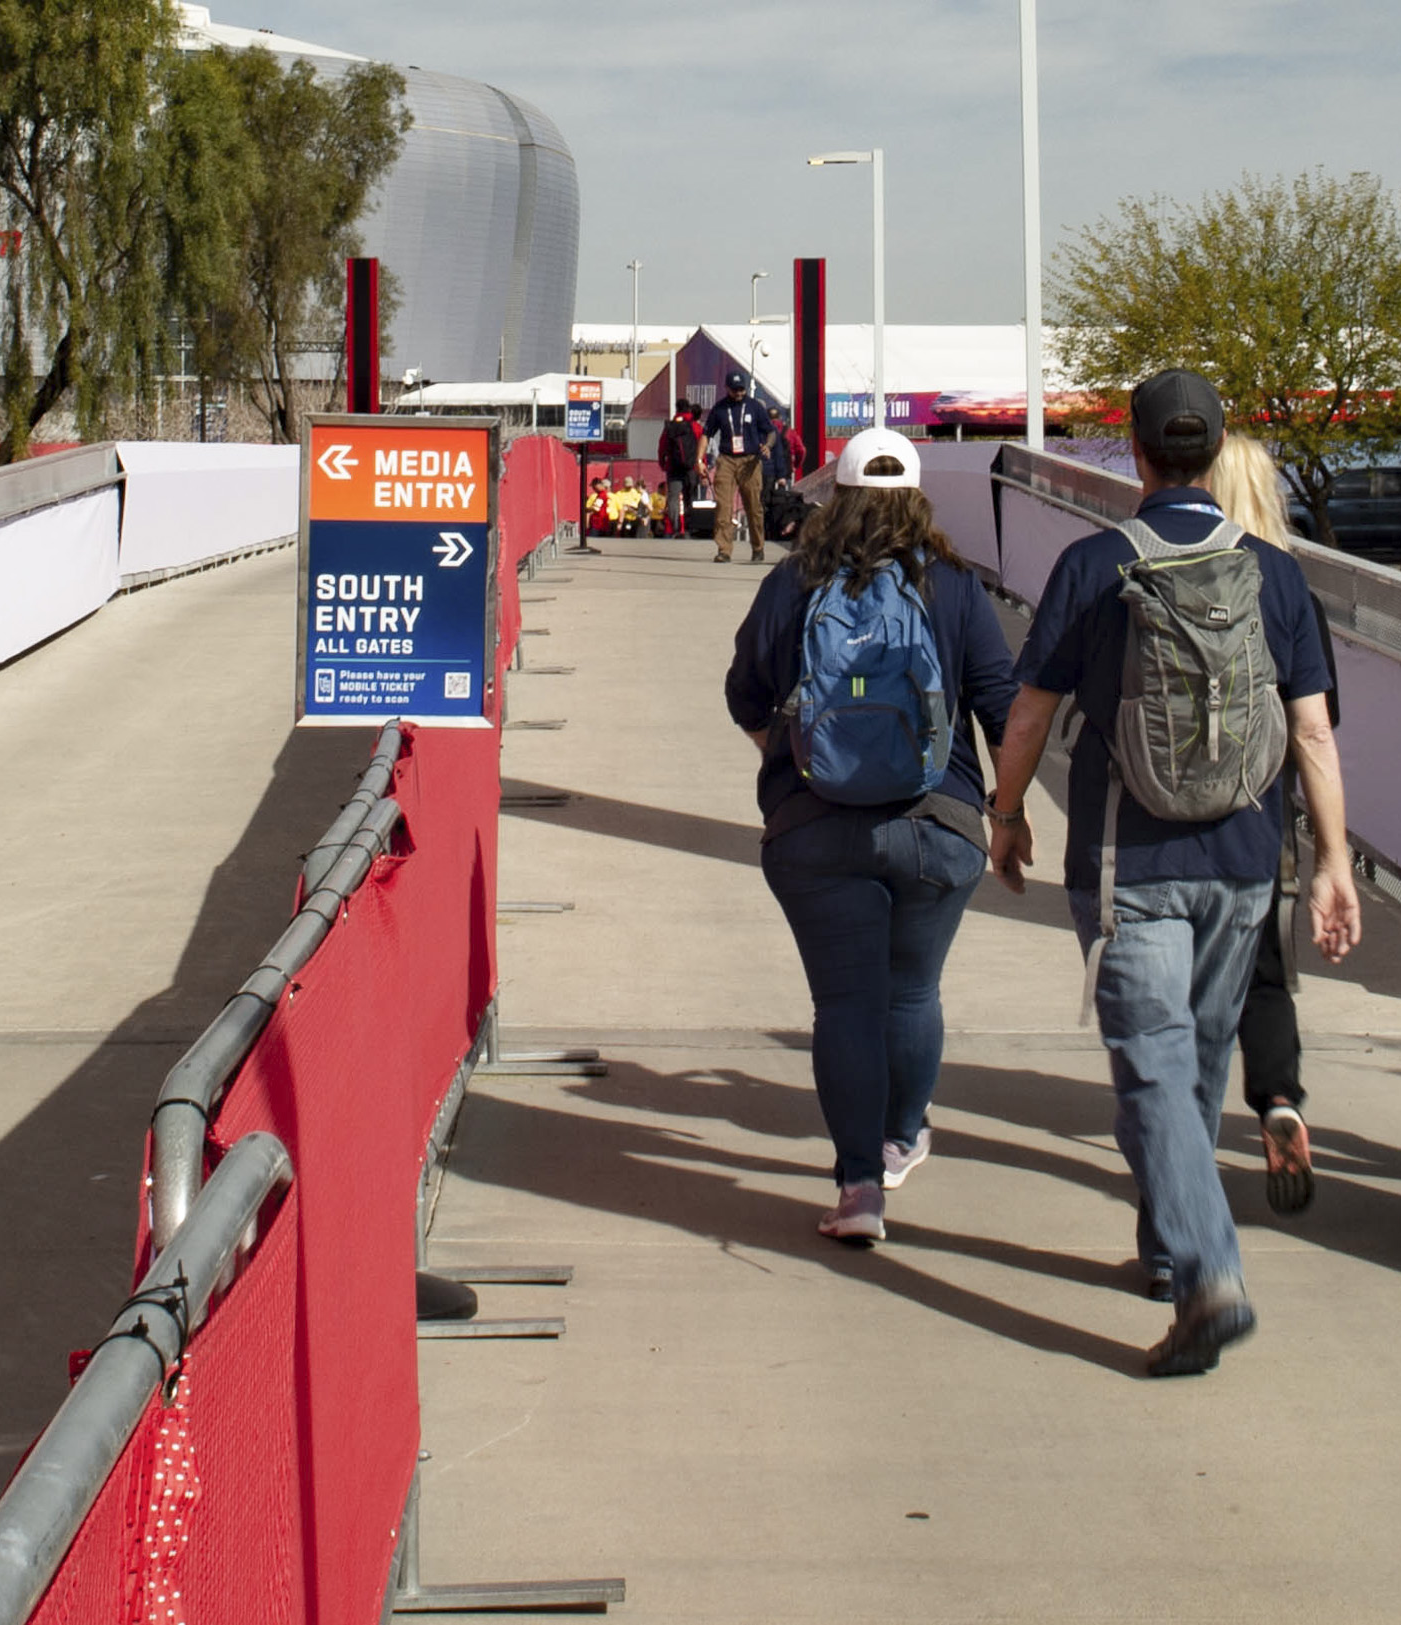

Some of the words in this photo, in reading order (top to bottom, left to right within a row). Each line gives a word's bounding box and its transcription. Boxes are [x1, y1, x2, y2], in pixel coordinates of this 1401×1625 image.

[375, 450, 474, 477] MEDIA
[374, 481, 476, 509] ENTRY
[316, 574, 424, 601] SOUTH
[315, 605, 421, 632] ENTRY
[315, 638, 349, 653] ALL
[355, 638, 414, 654] GATES
[339, 669, 374, 680] Please
[376, 670, 401, 680] have
[403, 672, 426, 682] your
[339, 682, 378, 692] MOBILE
[380, 682, 416, 692] TICKET
[339, 693, 368, 705] ready
[371, 694, 383, 704] to
[384, 696, 410, 704] scan
